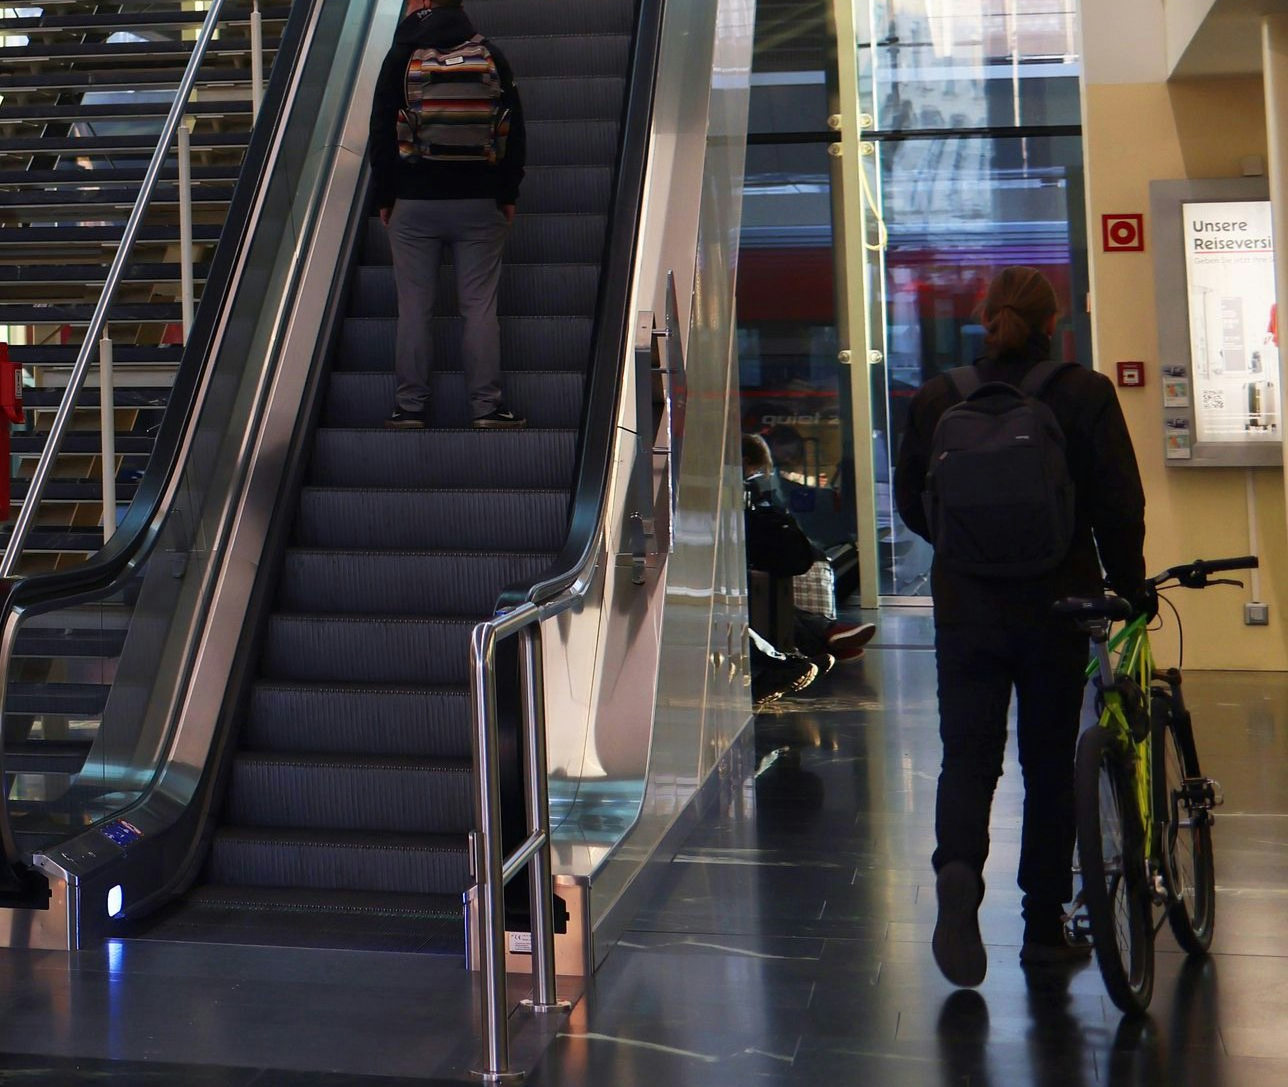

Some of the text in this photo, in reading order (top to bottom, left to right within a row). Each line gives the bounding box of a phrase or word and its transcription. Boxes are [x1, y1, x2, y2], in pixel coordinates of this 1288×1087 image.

[1193, 220, 1248, 233] Unsere
[1194, 236, 1272, 250] Reiseversi
[762, 412, 820, 427] quiet
